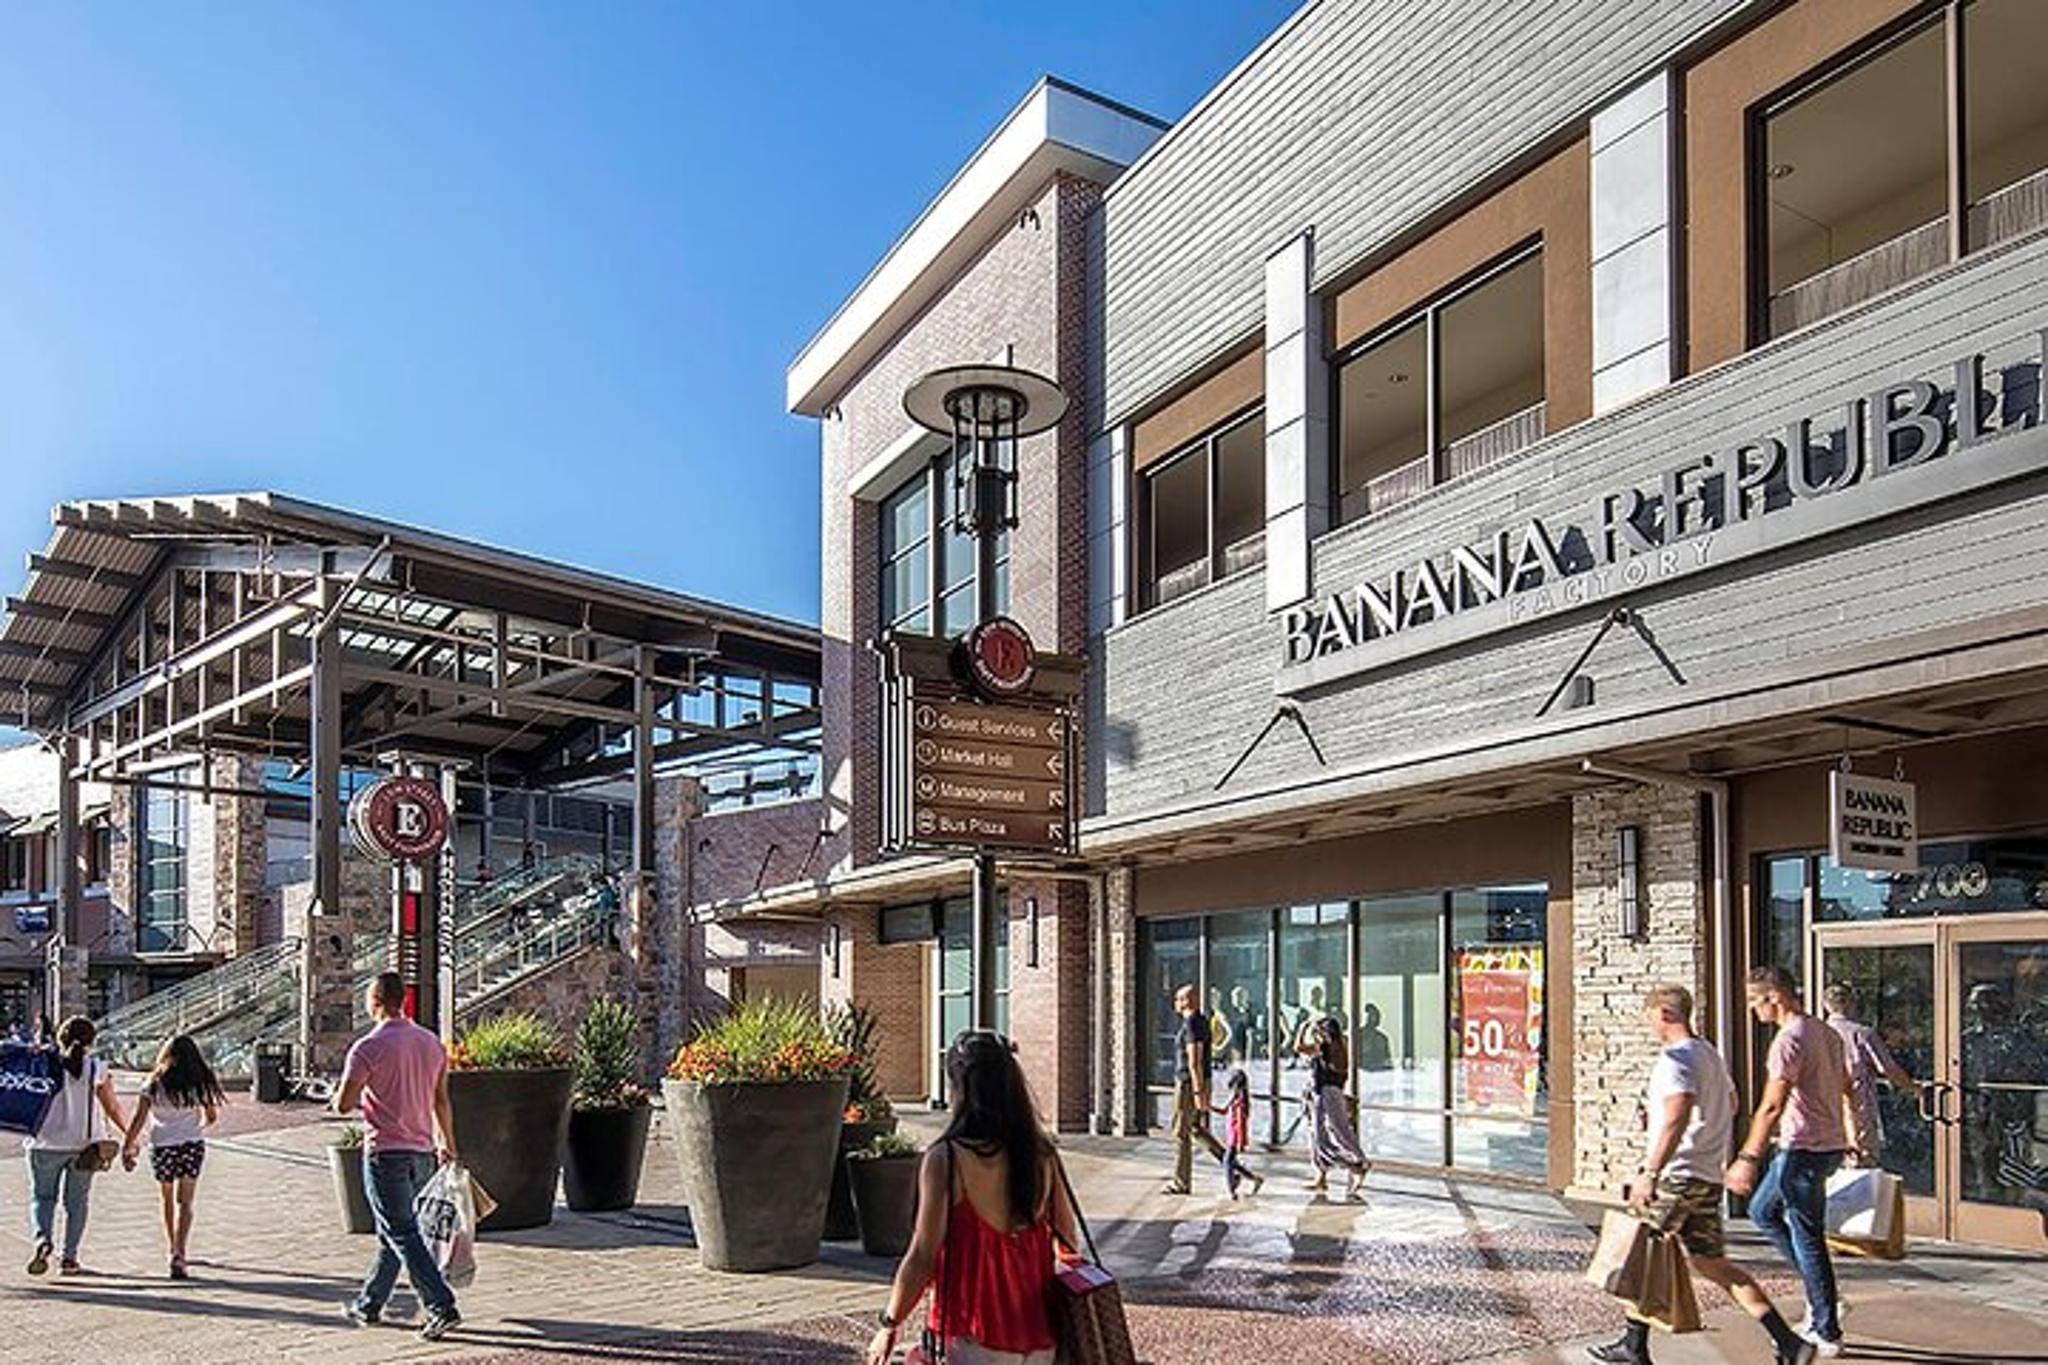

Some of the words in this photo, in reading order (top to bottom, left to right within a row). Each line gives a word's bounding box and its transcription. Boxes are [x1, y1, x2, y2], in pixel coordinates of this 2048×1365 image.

[1282, 517, 1569, 668] BANANA
[1509, 536, 1714, 621] FACTORY
[938, 712, 979, 733] Guest
[980, 718, 1037, 739] Services
[940, 746, 985, 767] Market
[987, 752, 1015, 768] Hall
[940, 781, 1026, 804] Management
[1844, 788, 1908, 816] BANANA
[396, 802, 421, 837] E
[940, 815, 967, 833] Bus
[968, 817, 1006, 836] Plaza
[1841, 814, 1913, 843] REPUBLIC
